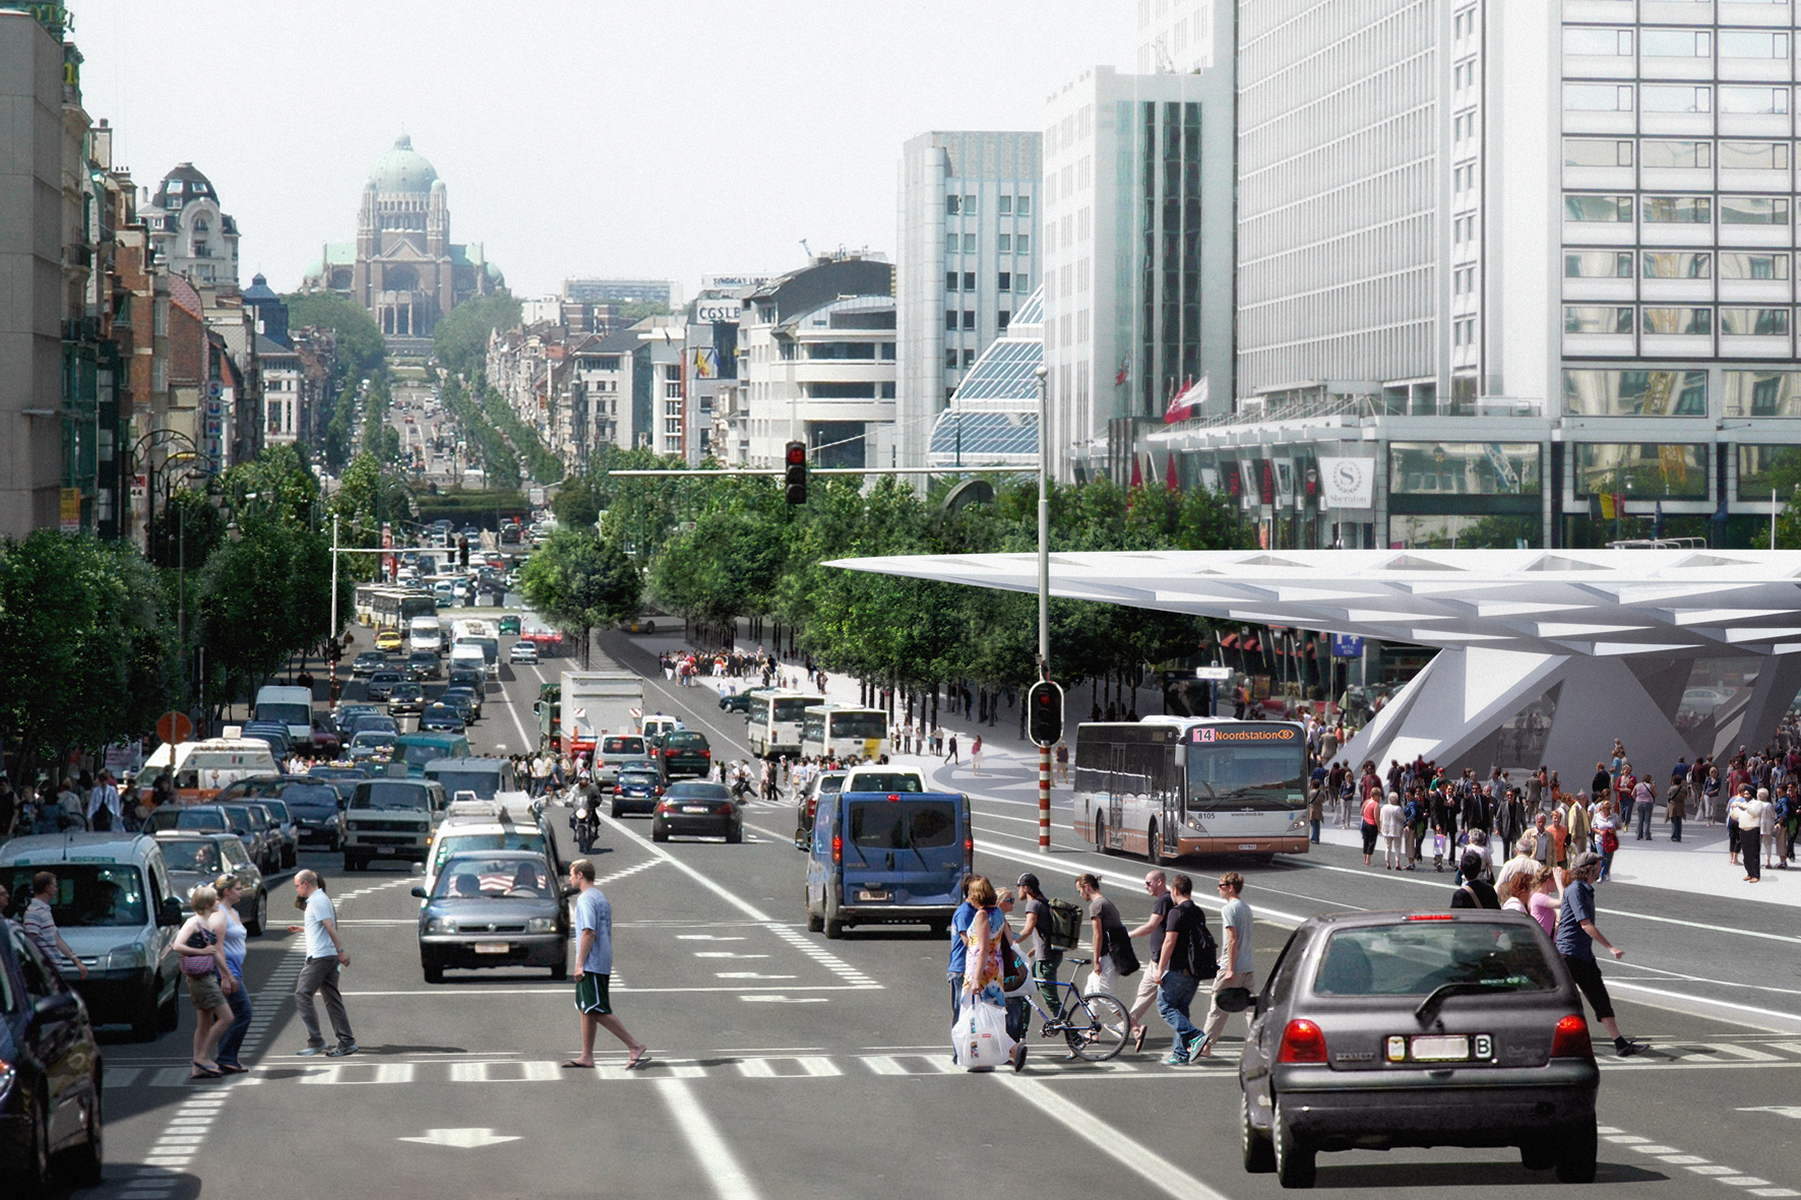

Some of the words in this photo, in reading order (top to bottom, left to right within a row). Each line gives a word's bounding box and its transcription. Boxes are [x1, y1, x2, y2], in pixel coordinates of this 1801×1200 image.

[1197, 728, 1212, 741] 14
[1215, 730, 1279, 741] Noordstation
[1198, 812, 1215, 820] 8105
[1477, 1038, 1490, 1054] B
